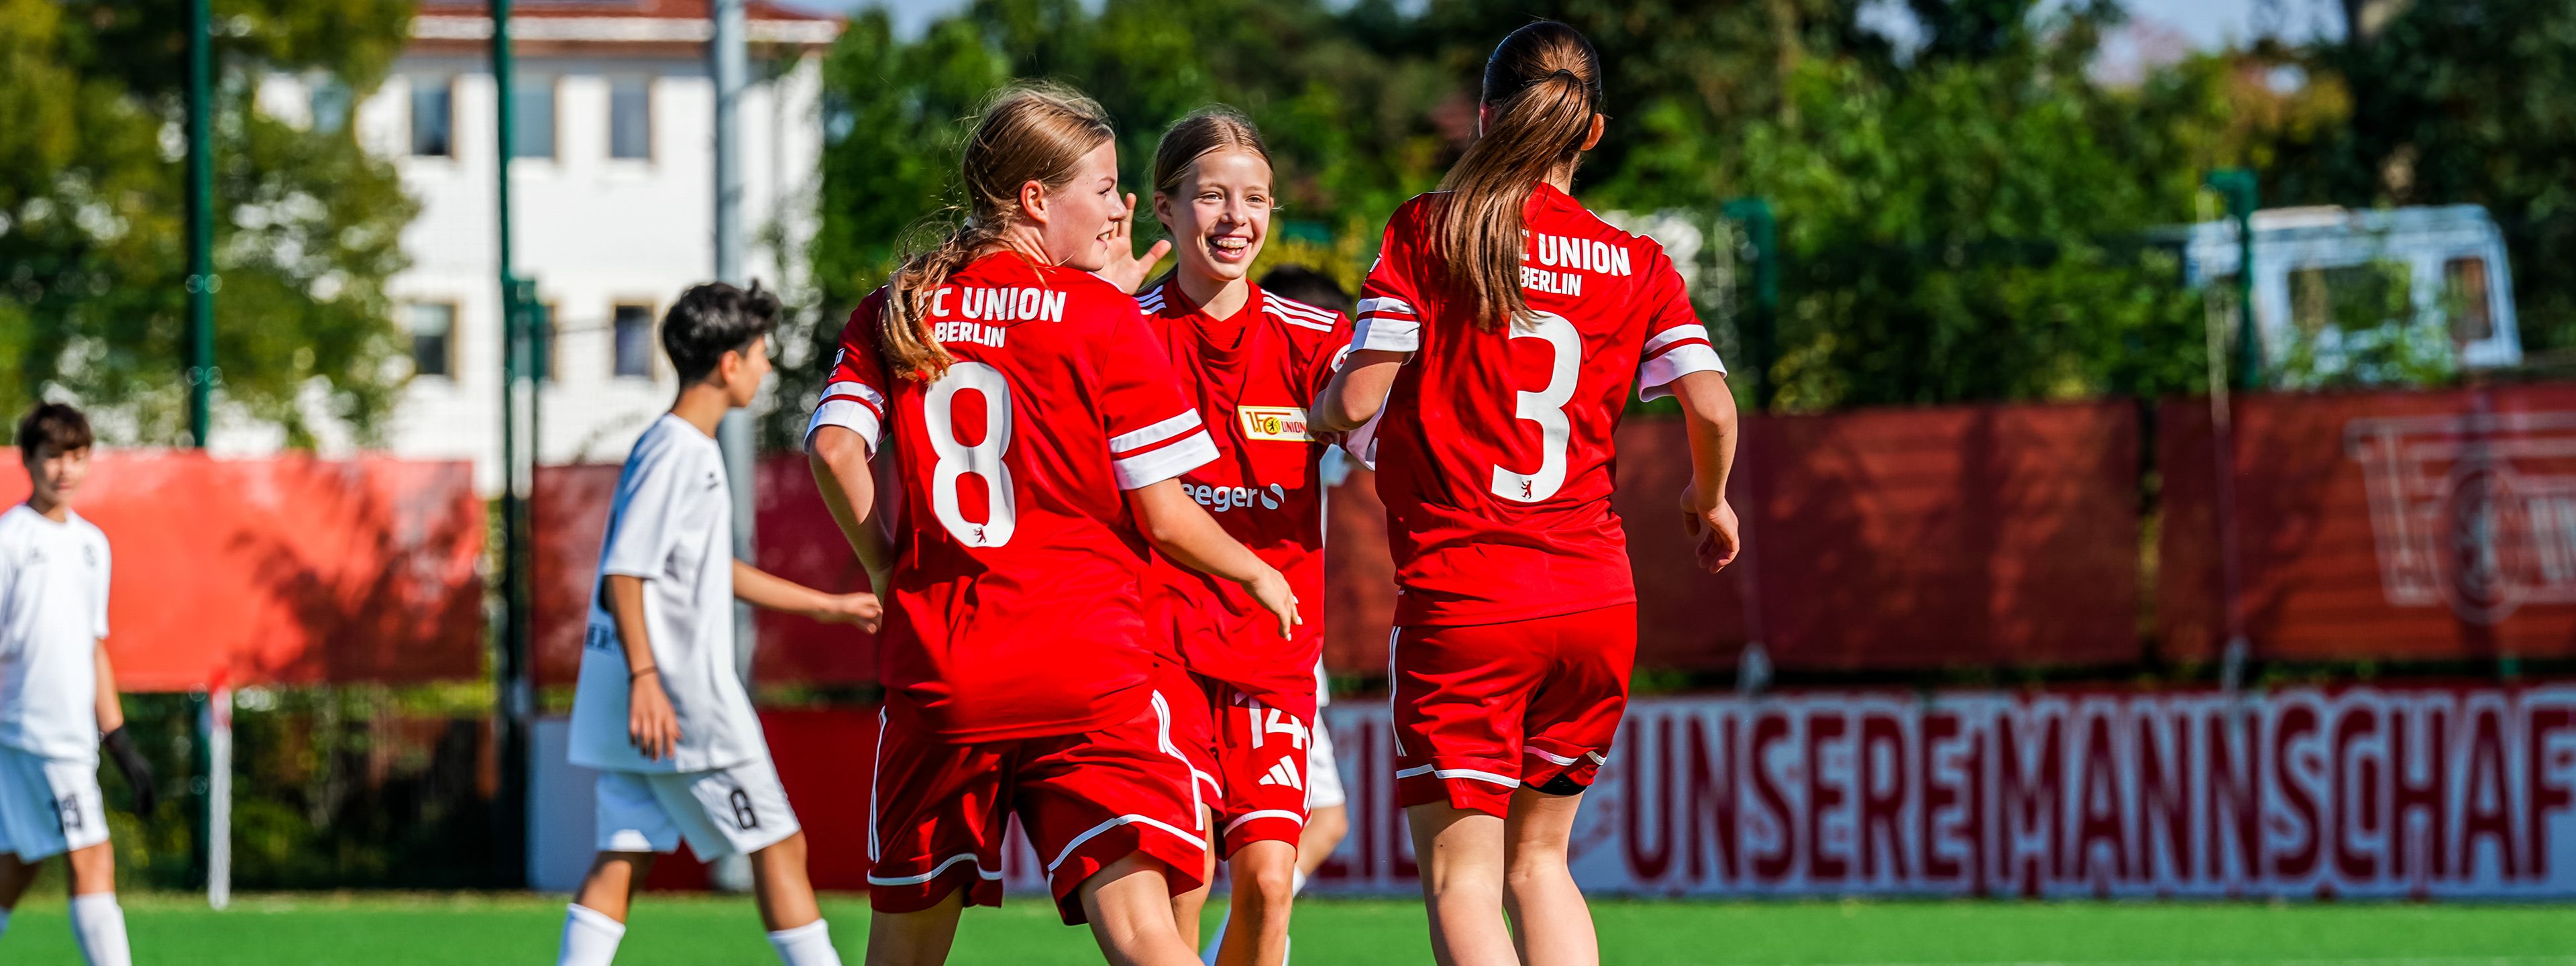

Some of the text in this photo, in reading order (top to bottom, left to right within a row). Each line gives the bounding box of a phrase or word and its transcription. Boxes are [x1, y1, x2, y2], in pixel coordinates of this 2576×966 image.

[1539, 233, 1631, 276] UNION
[1519, 266, 1582, 297] BERLIN
[961, 286, 1067, 322] UNION
[935, 321, 1006, 348] BERLIN
[1281, 421, 1307, 433] UNION
[1491, 310, 1581, 502] 3
[924, 361, 1016, 547] 8
[1235, 691, 1305, 750] 14
[1623, 712, 1962, 882] UNSERE
